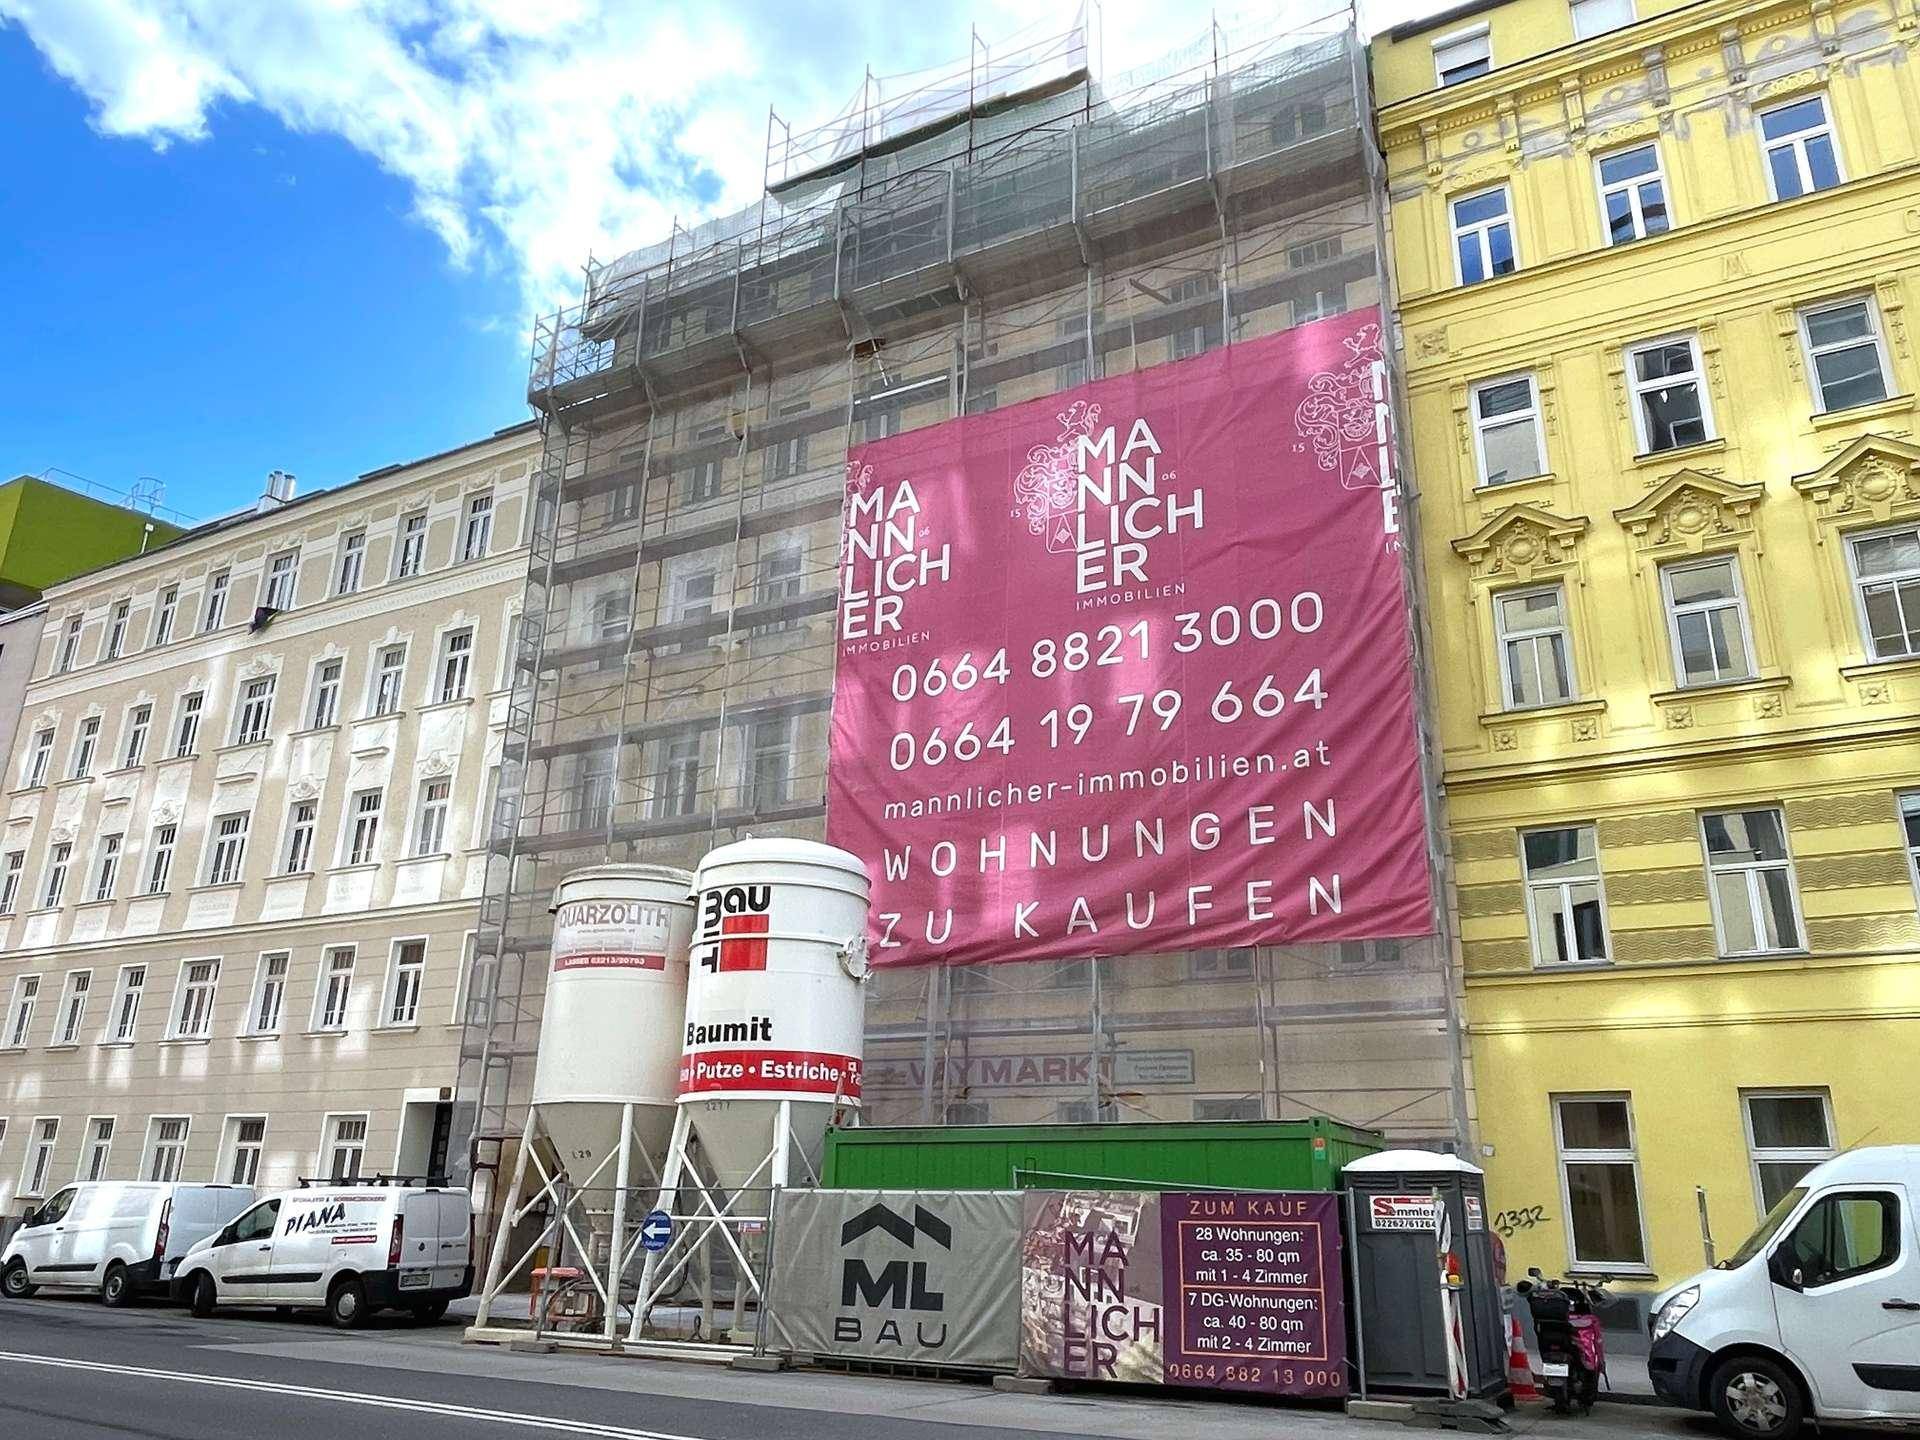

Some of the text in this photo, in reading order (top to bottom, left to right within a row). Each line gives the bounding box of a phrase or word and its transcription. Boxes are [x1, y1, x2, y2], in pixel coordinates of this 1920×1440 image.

[1078, 418, 1162, 473] MA
[849, 479, 921, 527] MA
[1078, 456, 1156, 513] NN
[1077, 488, 1204, 552] LICH
[848, 515, 916, 564] NN
[844, 543, 950, 601] LICH
[1077, 542, 1149, 594] ER
[1076, 583, 1186, 611] IMMOBILIEN
[842, 594, 904, 640] ER
[842, 631, 931, 657] IMMOBILIEN
[891, 591, 1325, 702] 0664 8821 3000
[890, 668, 1329, 771] 0664 19 79 664
[884, 739, 1332, 821] mannlicher-immobilien.at
[884, 798, 1337, 882] WOHNUNGEN
[879, 873, 1343, 948] ZU KAUFEN
[686, 1016, 773, 1046] Baumit
[696, 1061, 744, 1080] Putze
[761, 1060, 839, 1082] Estriche
[284, 1203, 346, 1236] PIANA
[1189, 1200, 1307, 1216] ZUM KAUF
[1064, 1230, 1129, 1267] MA
[1195, 1227, 1304, 1246] 28 Wohnungen:
[1201, 1250, 1222, 1261] ca.
[1225, 1248, 1243, 1262] 35
[1256, 1248, 1274, 1262] 80
[1278, 1251, 1300, 1266] qm
[841, 1258, 944, 1311] ML
[1064, 1266, 1124, 1303] NN
[1196, 1268, 1216, 1281] mit
[1221, 1269, 1227, 1281] 1
[1242, 1269, 1251, 1281] 4
[1255, 1268, 1308, 1285] Zimmer
[1188, 1292, 1318, 1313] 7 DG-Wohnungen:
[834, 1316, 948, 1348] BAU
[1064, 1303, 1160, 1342] LICH
[1203, 1316, 1224, 1328] ca.
[1228, 1315, 1246, 1329] 40
[1259, 1316, 1277, 1331] 80
[1281, 1319, 1304, 1334] qm
[1197, 1335, 1218, 1349] mit
[1222, 1336, 1231, 1350] 2
[1244, 1337, 1253, 1350] 4
[1258, 1337, 1312, 1353] Zimmer
[1272, 1368, 1294, 1384] 13
[1304, 1370, 1341, 1387] 000
